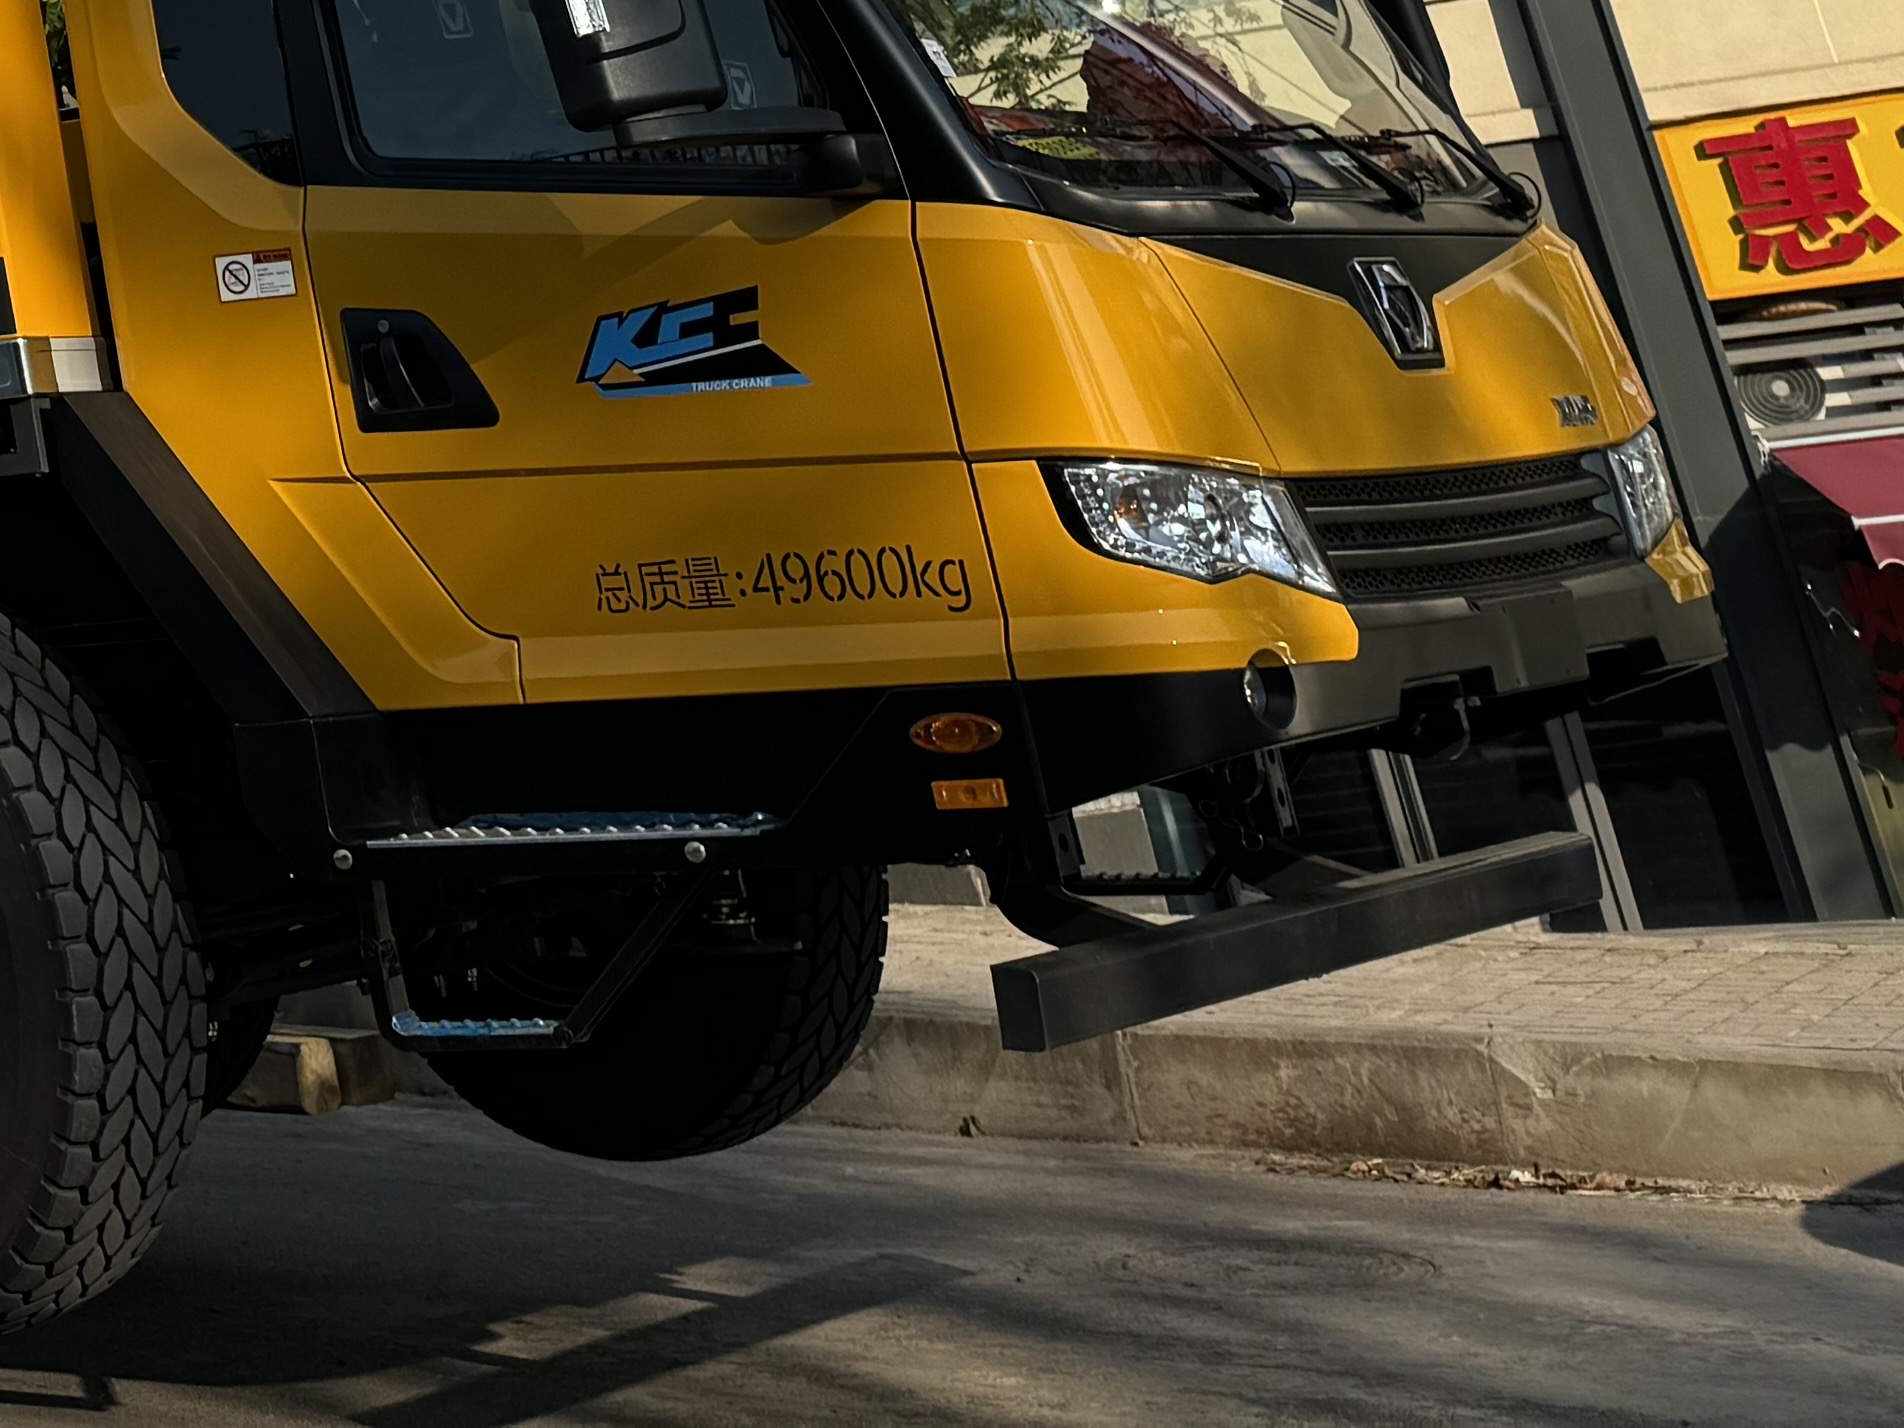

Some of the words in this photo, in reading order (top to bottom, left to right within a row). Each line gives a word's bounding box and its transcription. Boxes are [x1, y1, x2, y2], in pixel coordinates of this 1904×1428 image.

[1695, 116, 1904, 267] 惠
[692, 379, 730, 393] TRUCK
[733, 375, 773, 390] CRANE
[595, 544, 972, 614] 总质量:49600kg
